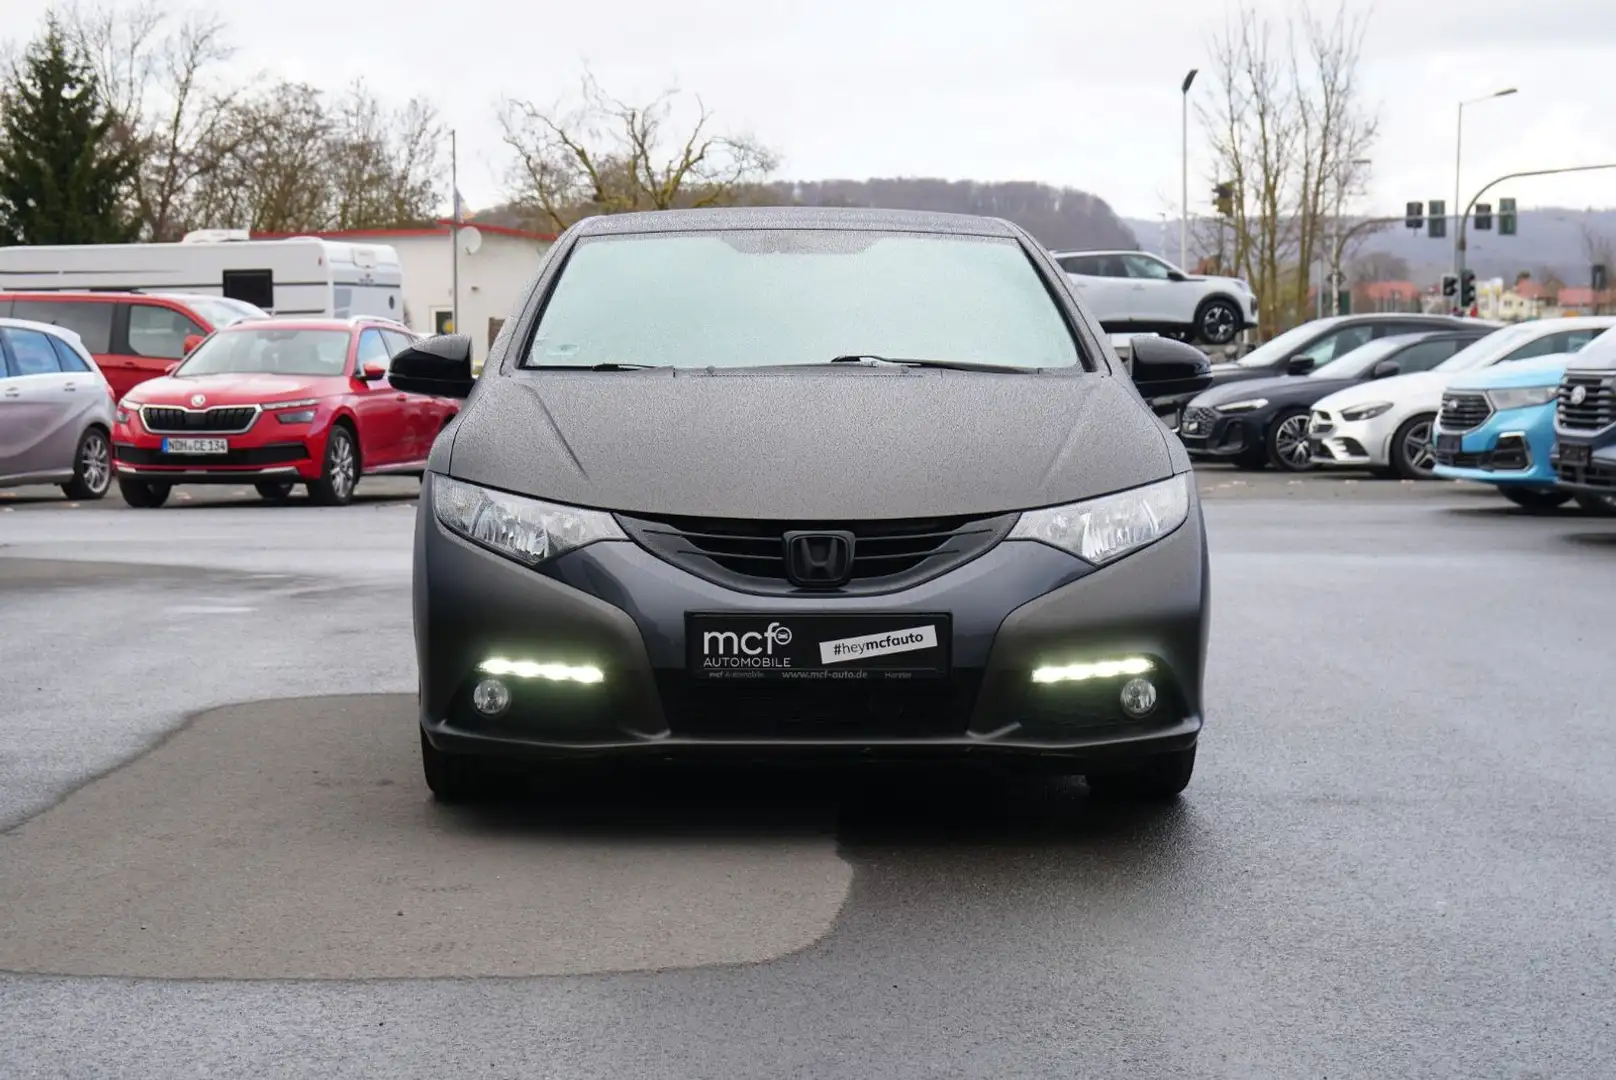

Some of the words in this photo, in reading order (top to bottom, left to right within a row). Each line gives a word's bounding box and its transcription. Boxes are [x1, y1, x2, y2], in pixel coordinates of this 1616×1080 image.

[703, 622, 780, 655] mcf
[833, 632, 924, 656] #heymcfauto
[703, 657, 792, 668] AUTOMOBILE
[782, 670, 868, 679] www.mcf-auto.de
